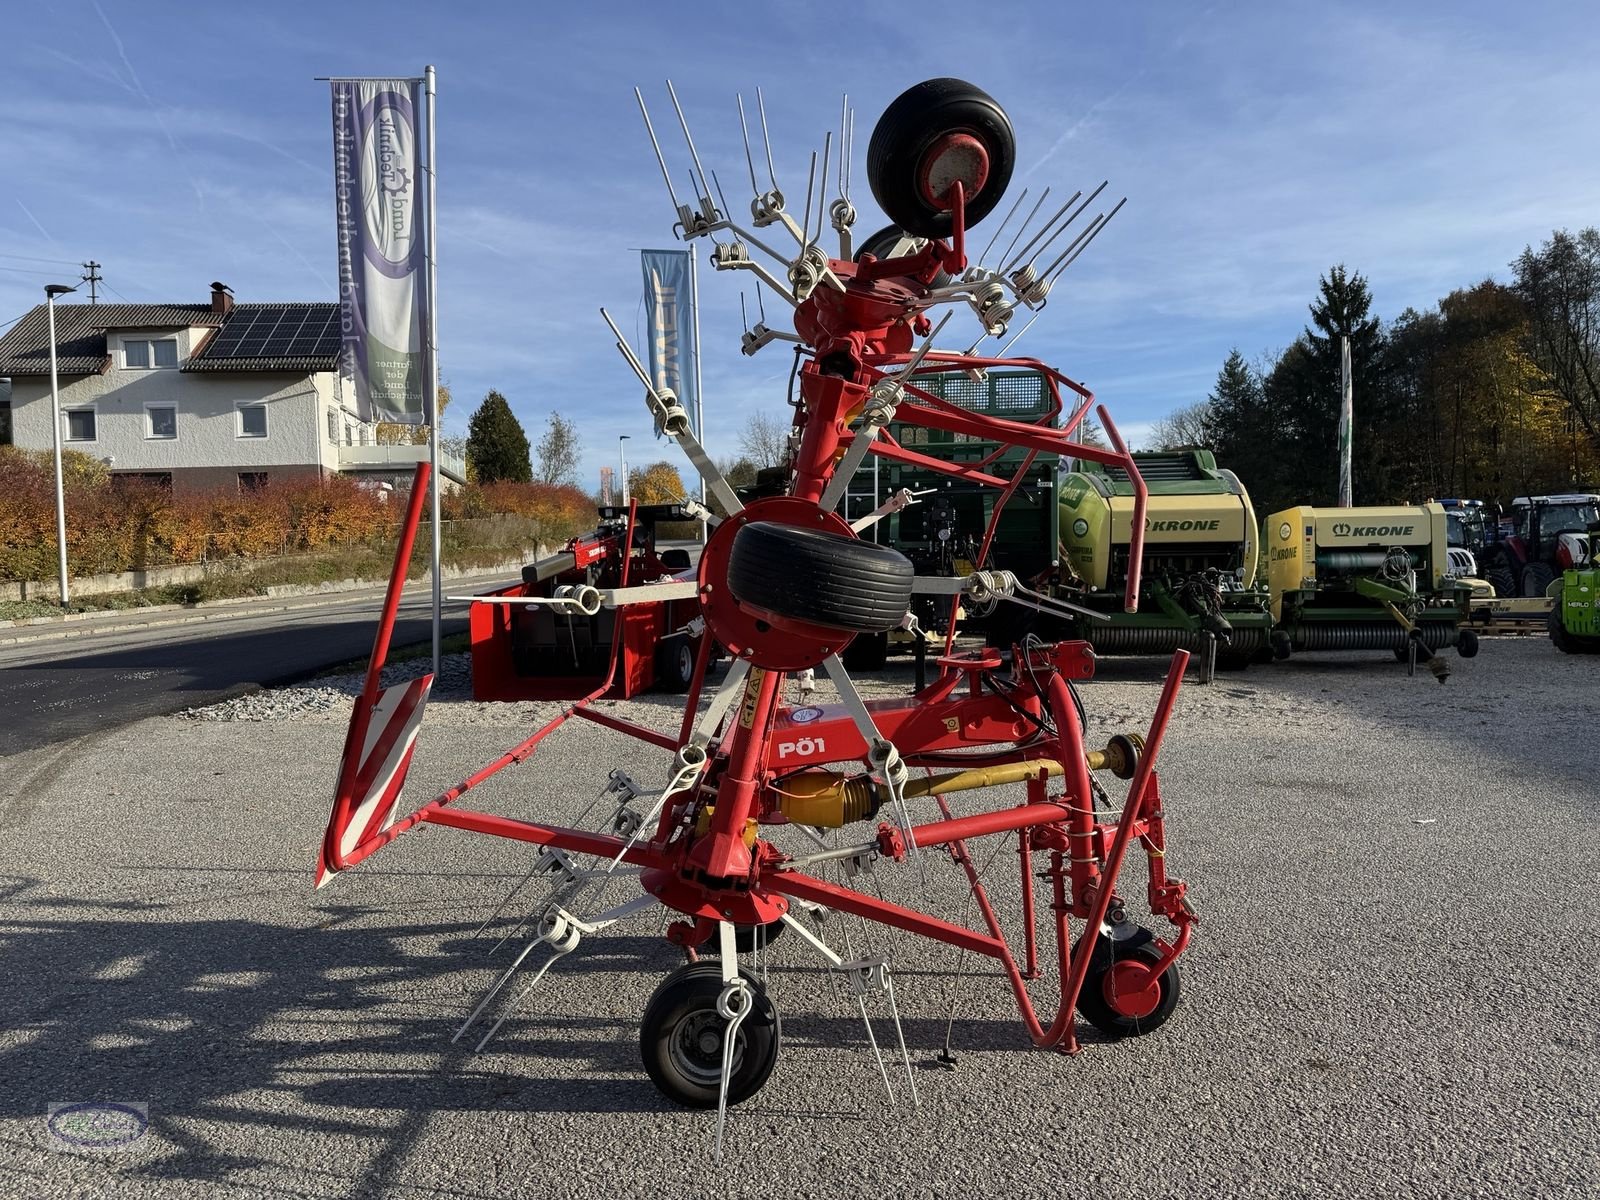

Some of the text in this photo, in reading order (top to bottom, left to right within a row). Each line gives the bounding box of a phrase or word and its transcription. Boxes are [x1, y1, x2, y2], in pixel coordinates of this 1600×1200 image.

[1152, 519, 1220, 532] KRONE
[1352, 525, 1414, 537] KRONE
[1276, 546, 1298, 561] KRONE
[1567, 601, 1590, 609] MERLO
